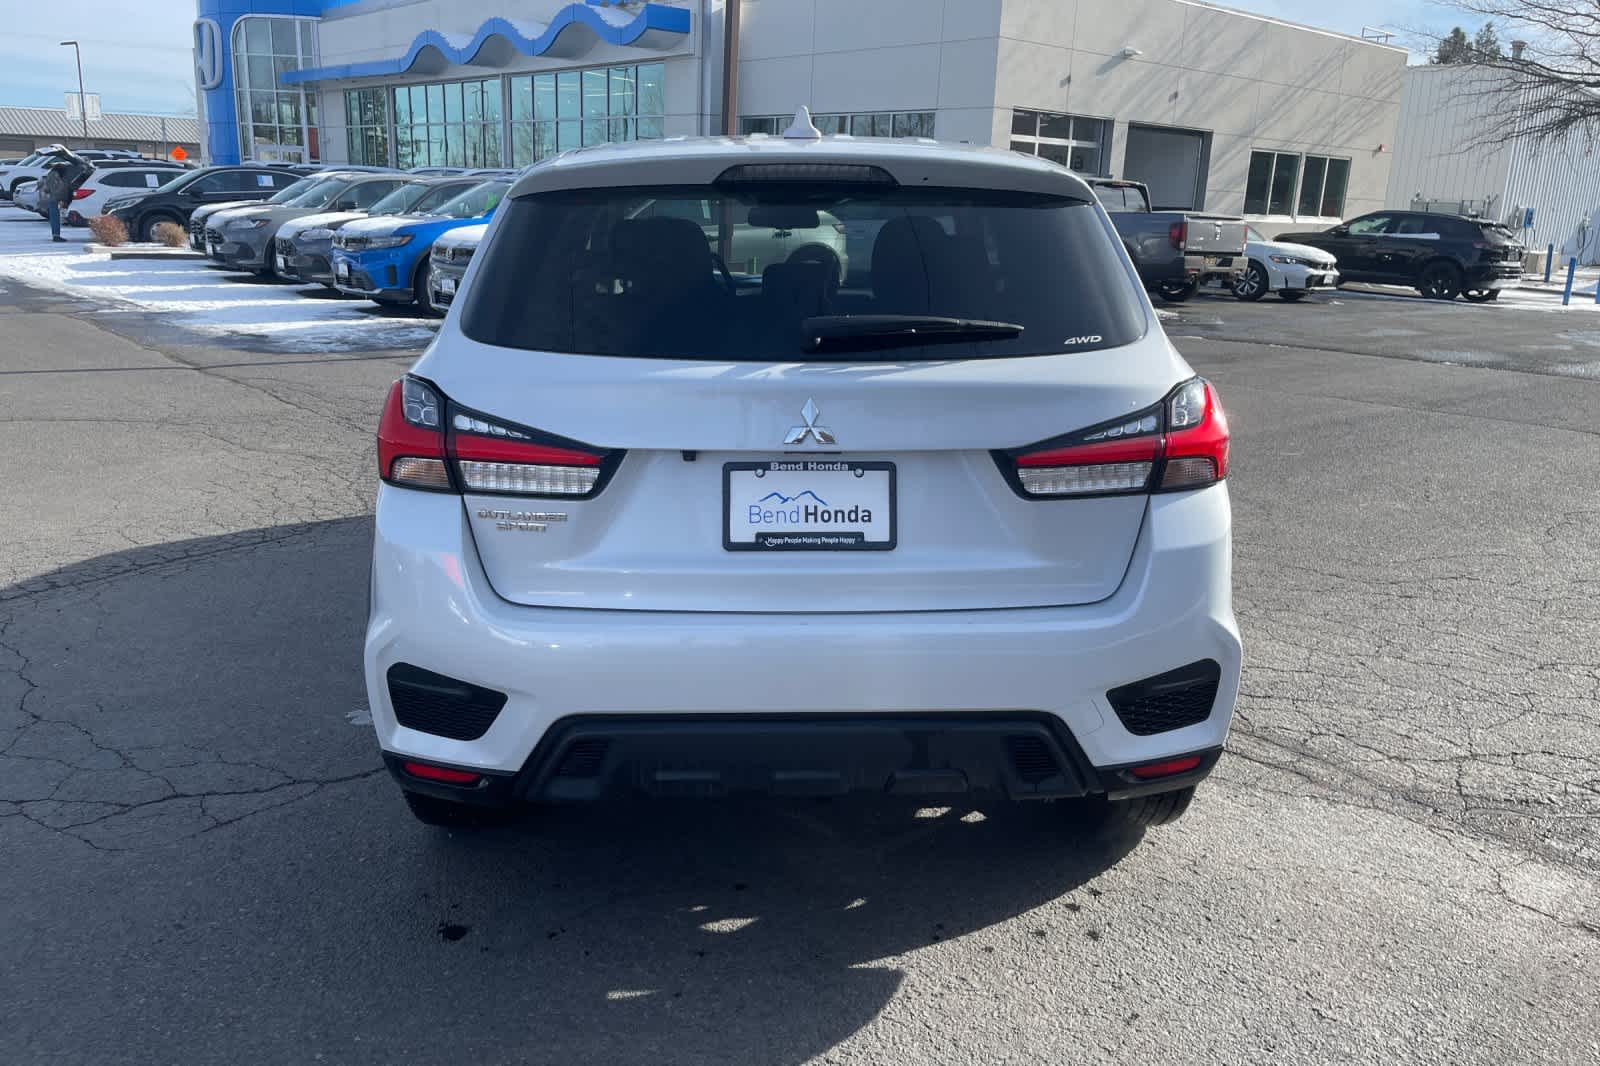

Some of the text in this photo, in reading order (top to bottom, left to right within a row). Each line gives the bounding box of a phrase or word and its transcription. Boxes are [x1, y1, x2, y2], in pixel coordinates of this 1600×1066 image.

[1063, 335, 1102, 345] 4WD
[770, 462, 849, 471] Bend Honda
[477, 509, 568, 521] OUTLANDER
[749, 505, 872, 524] Bend Honda
[495, 521, 547, 531] SPORT
[767, 536, 856, 545] Happy People Making People Happy
